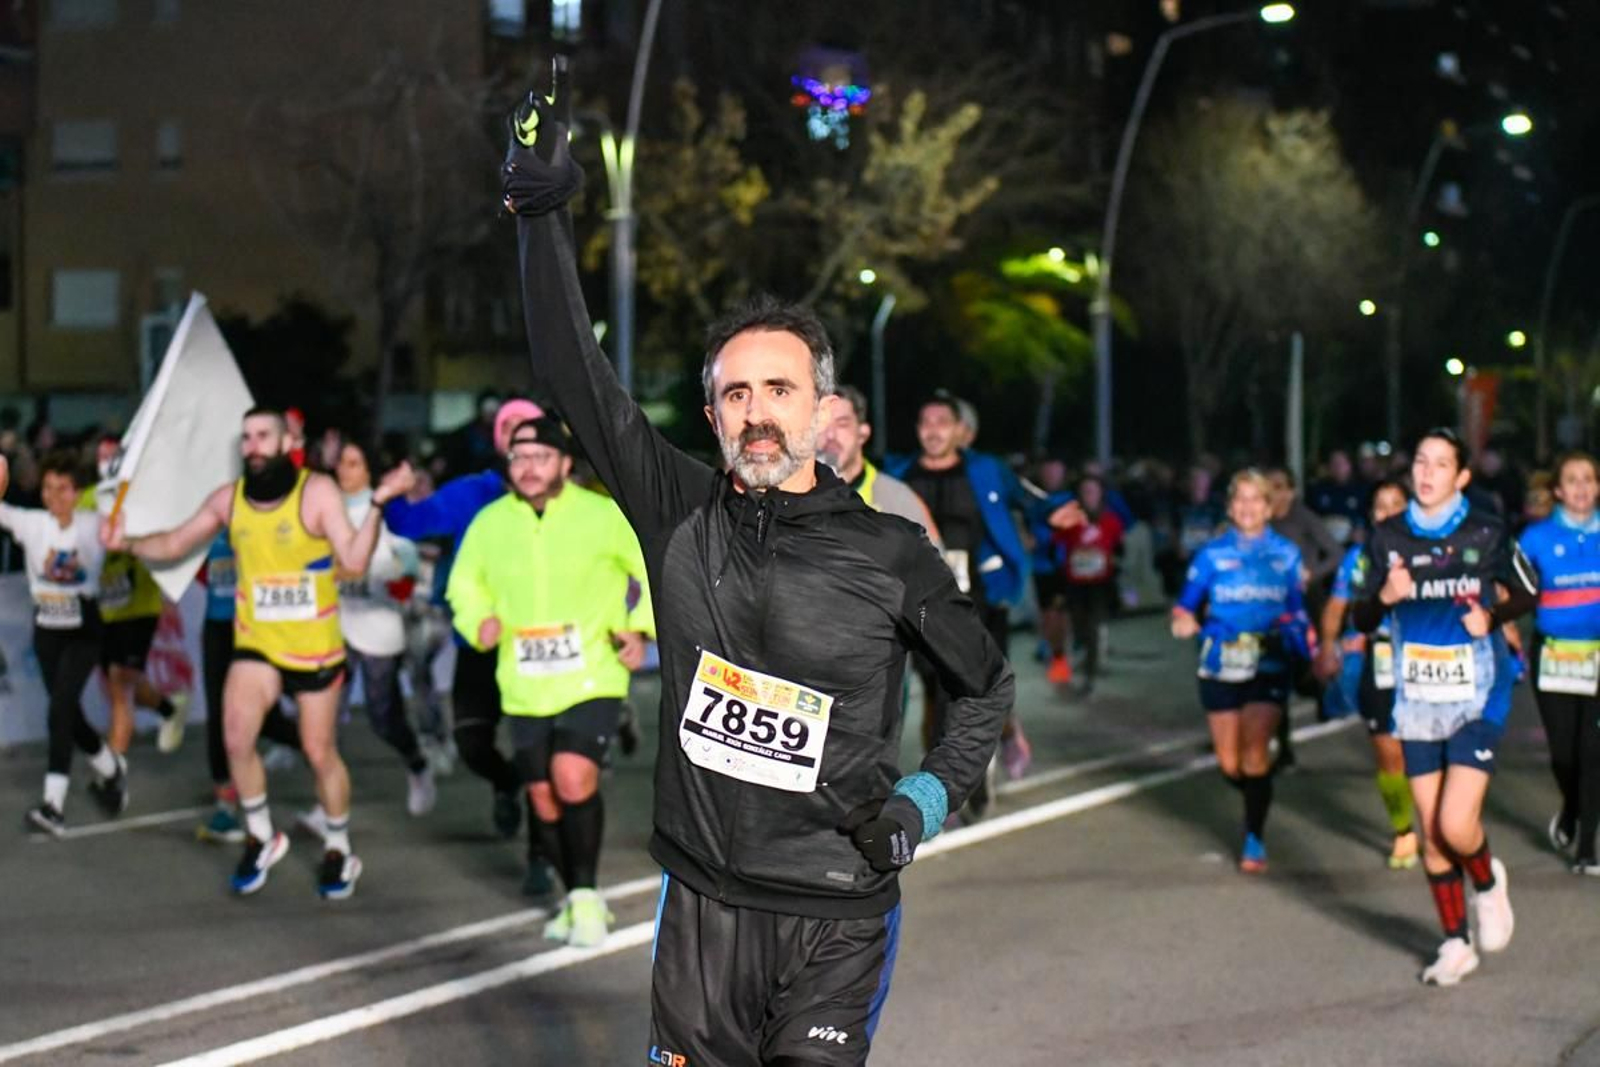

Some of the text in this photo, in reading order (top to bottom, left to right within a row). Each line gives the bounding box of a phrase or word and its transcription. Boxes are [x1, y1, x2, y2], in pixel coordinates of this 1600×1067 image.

[1421, 575, 1481, 599] ANTÓN
[1408, 661, 1466, 684] 8464
[700, 686, 809, 751] 7859
